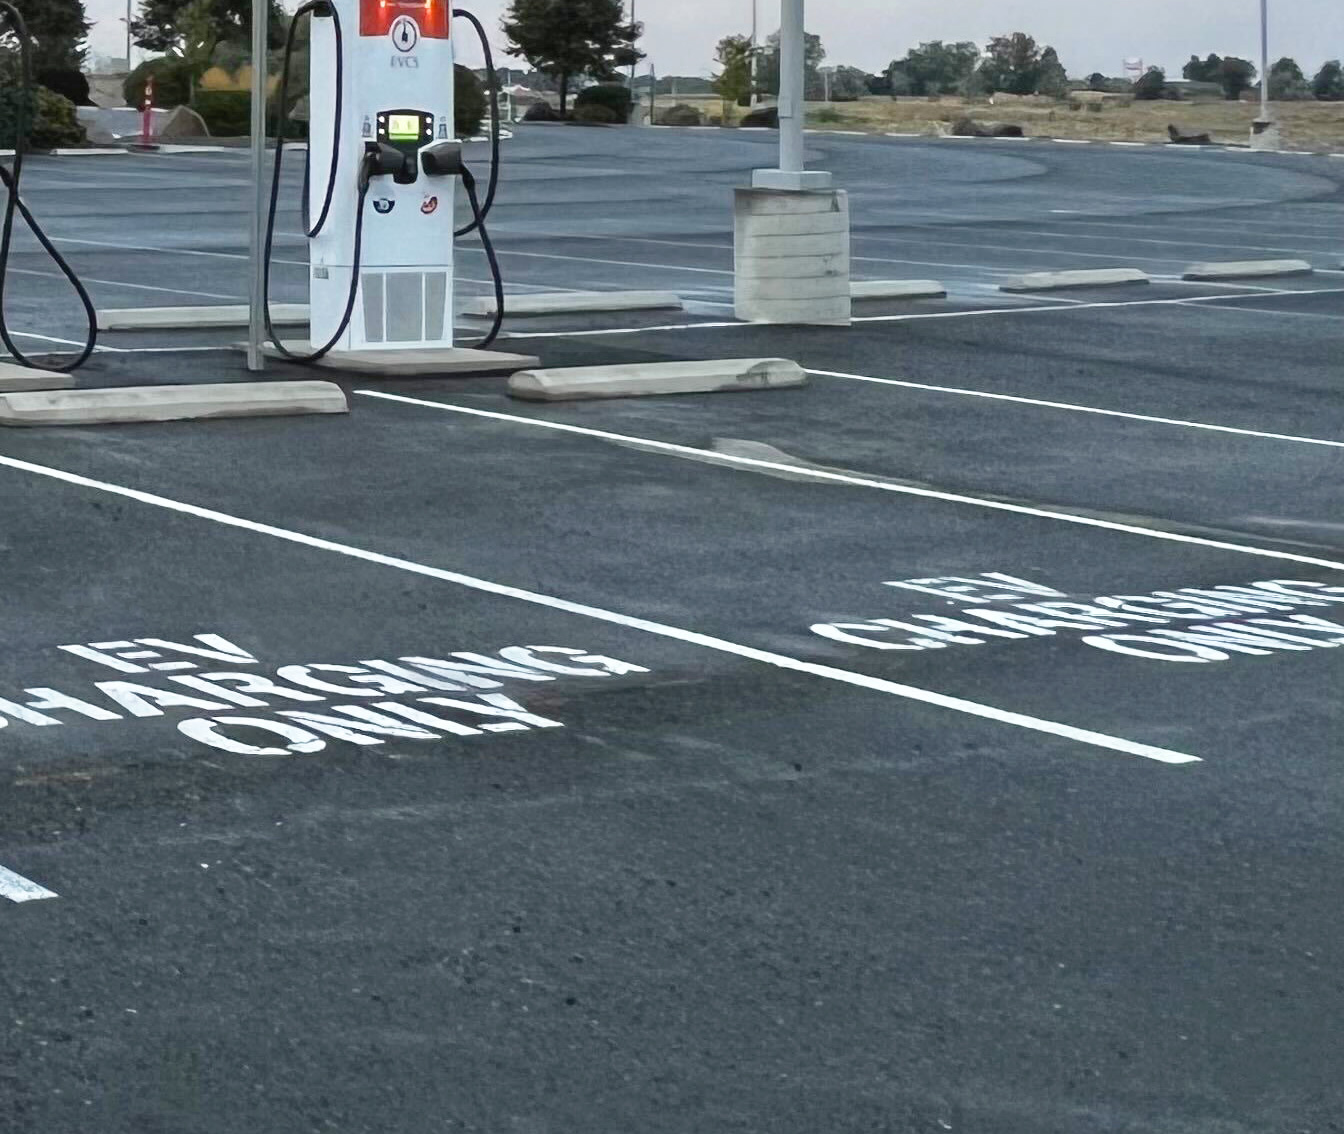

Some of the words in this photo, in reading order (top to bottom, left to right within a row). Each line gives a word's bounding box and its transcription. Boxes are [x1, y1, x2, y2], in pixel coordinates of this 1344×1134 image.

[882, 572, 1068, 604] EV
[56, 633, 260, 673] EV
[176, 692, 566, 755] ONLY
